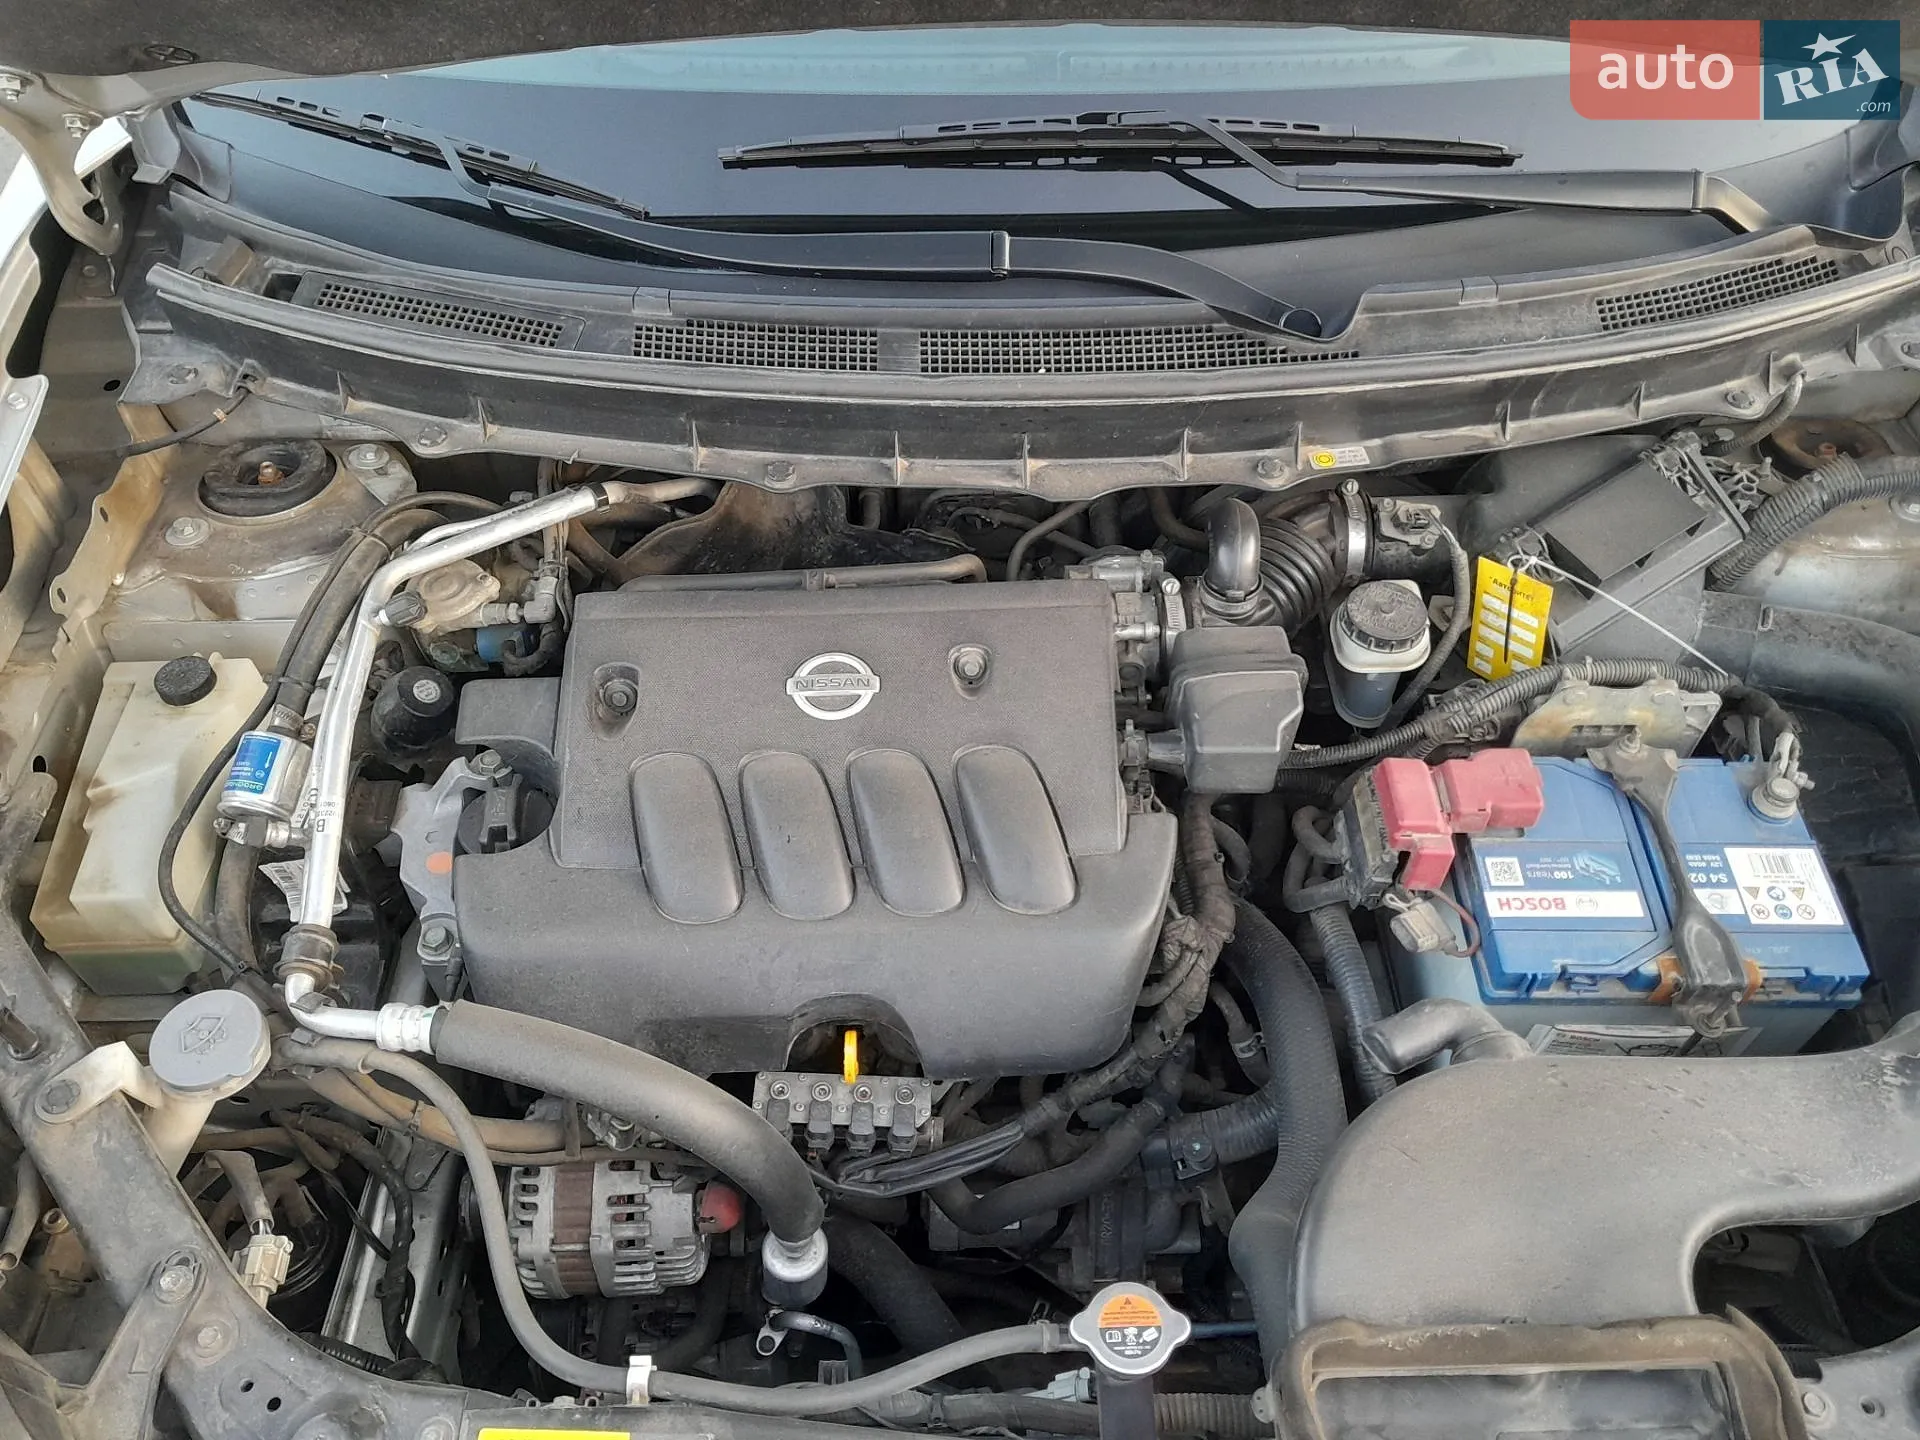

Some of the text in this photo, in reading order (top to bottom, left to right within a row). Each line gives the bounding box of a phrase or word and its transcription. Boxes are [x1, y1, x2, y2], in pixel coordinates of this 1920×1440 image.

[795, 678, 870, 689] NISSAN
[1526, 870, 1574, 879] 100 Years
[1709, 873, 1728, 884] S4
[1497, 896, 1567, 911] BOSCH
